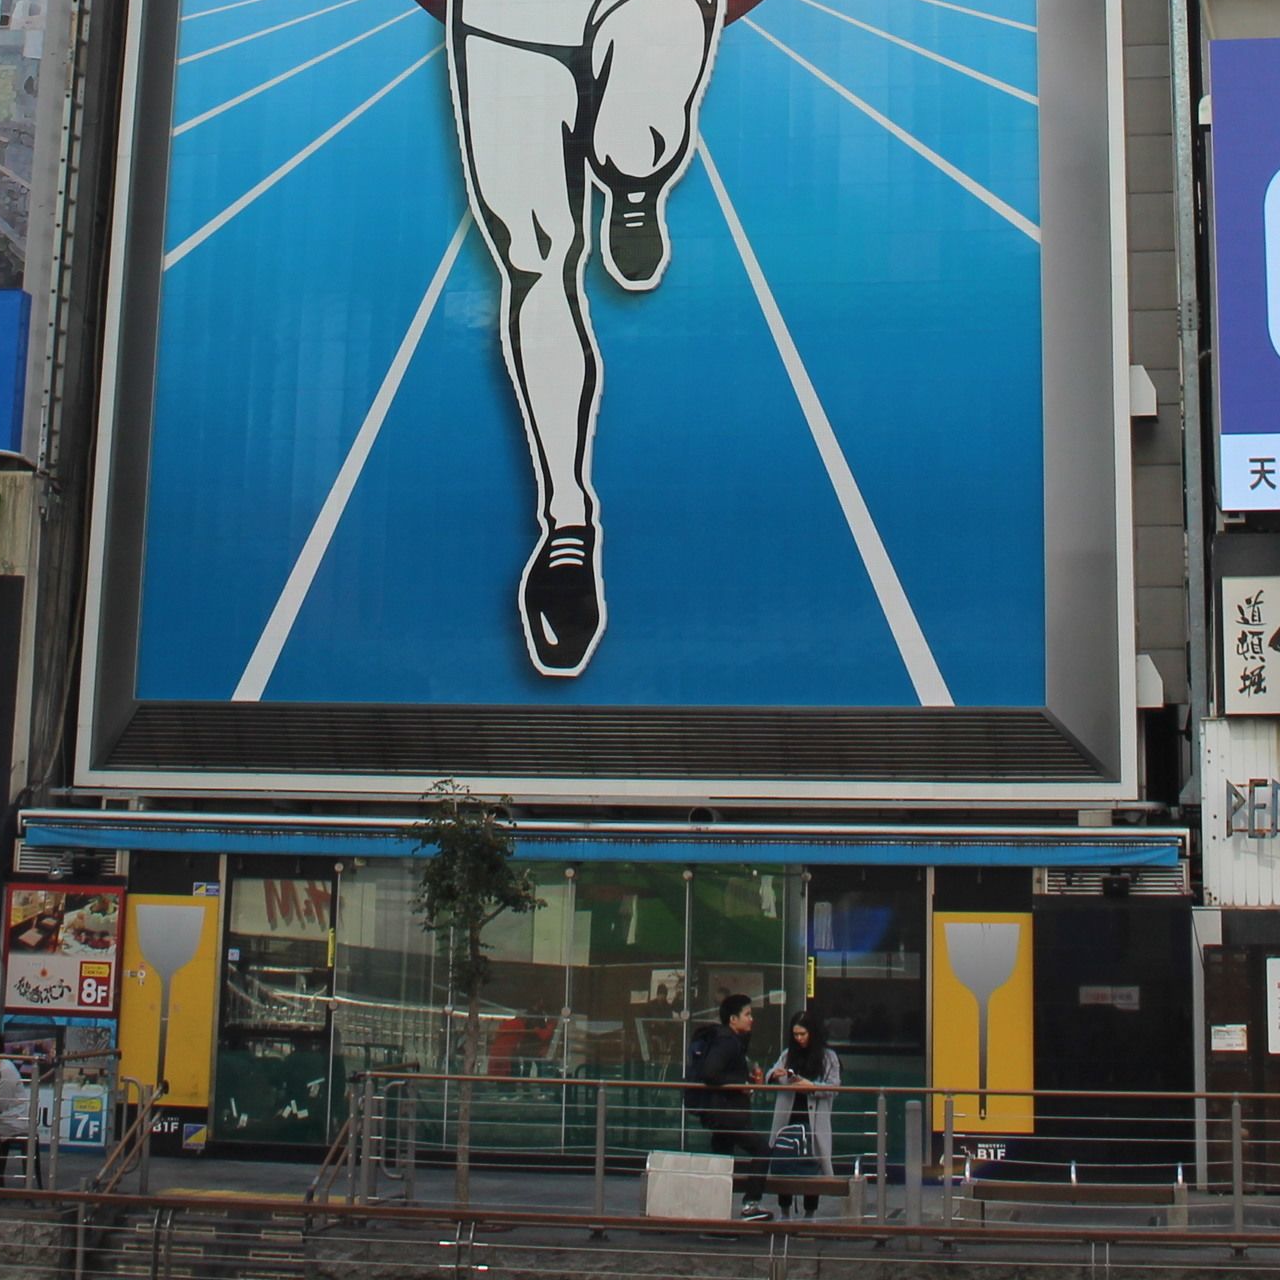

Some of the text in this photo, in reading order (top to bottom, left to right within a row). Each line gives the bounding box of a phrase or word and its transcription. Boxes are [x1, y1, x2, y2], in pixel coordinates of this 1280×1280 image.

[1236, 589, 1266, 697] 道頓堀
[81, 978, 108, 1005] 8F
[73, 1112, 100, 1139] 7F
[977, 1148, 1006, 1161] B1F
